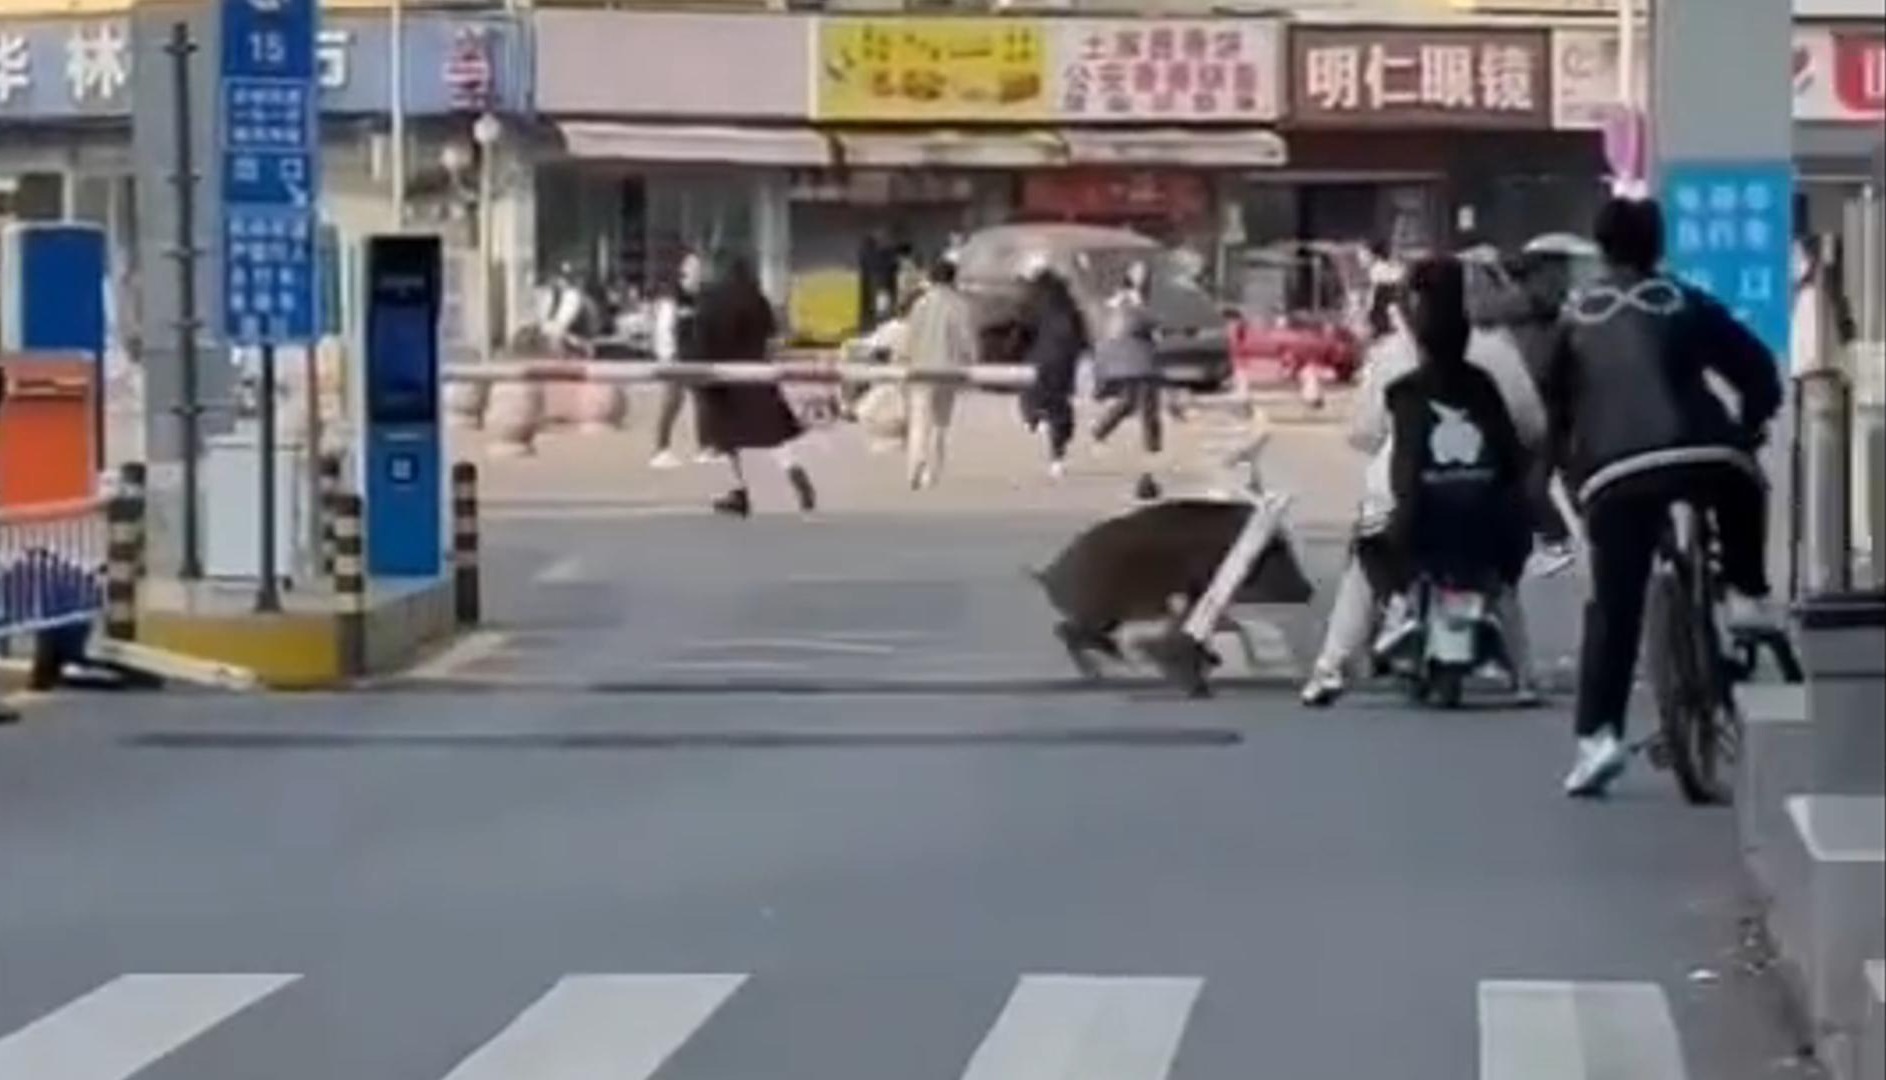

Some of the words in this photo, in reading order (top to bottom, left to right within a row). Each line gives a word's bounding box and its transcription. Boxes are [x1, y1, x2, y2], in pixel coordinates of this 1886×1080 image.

[248, 36, 286, 62] 15
[1306, 44, 1533, 110] 明仁眼镜
